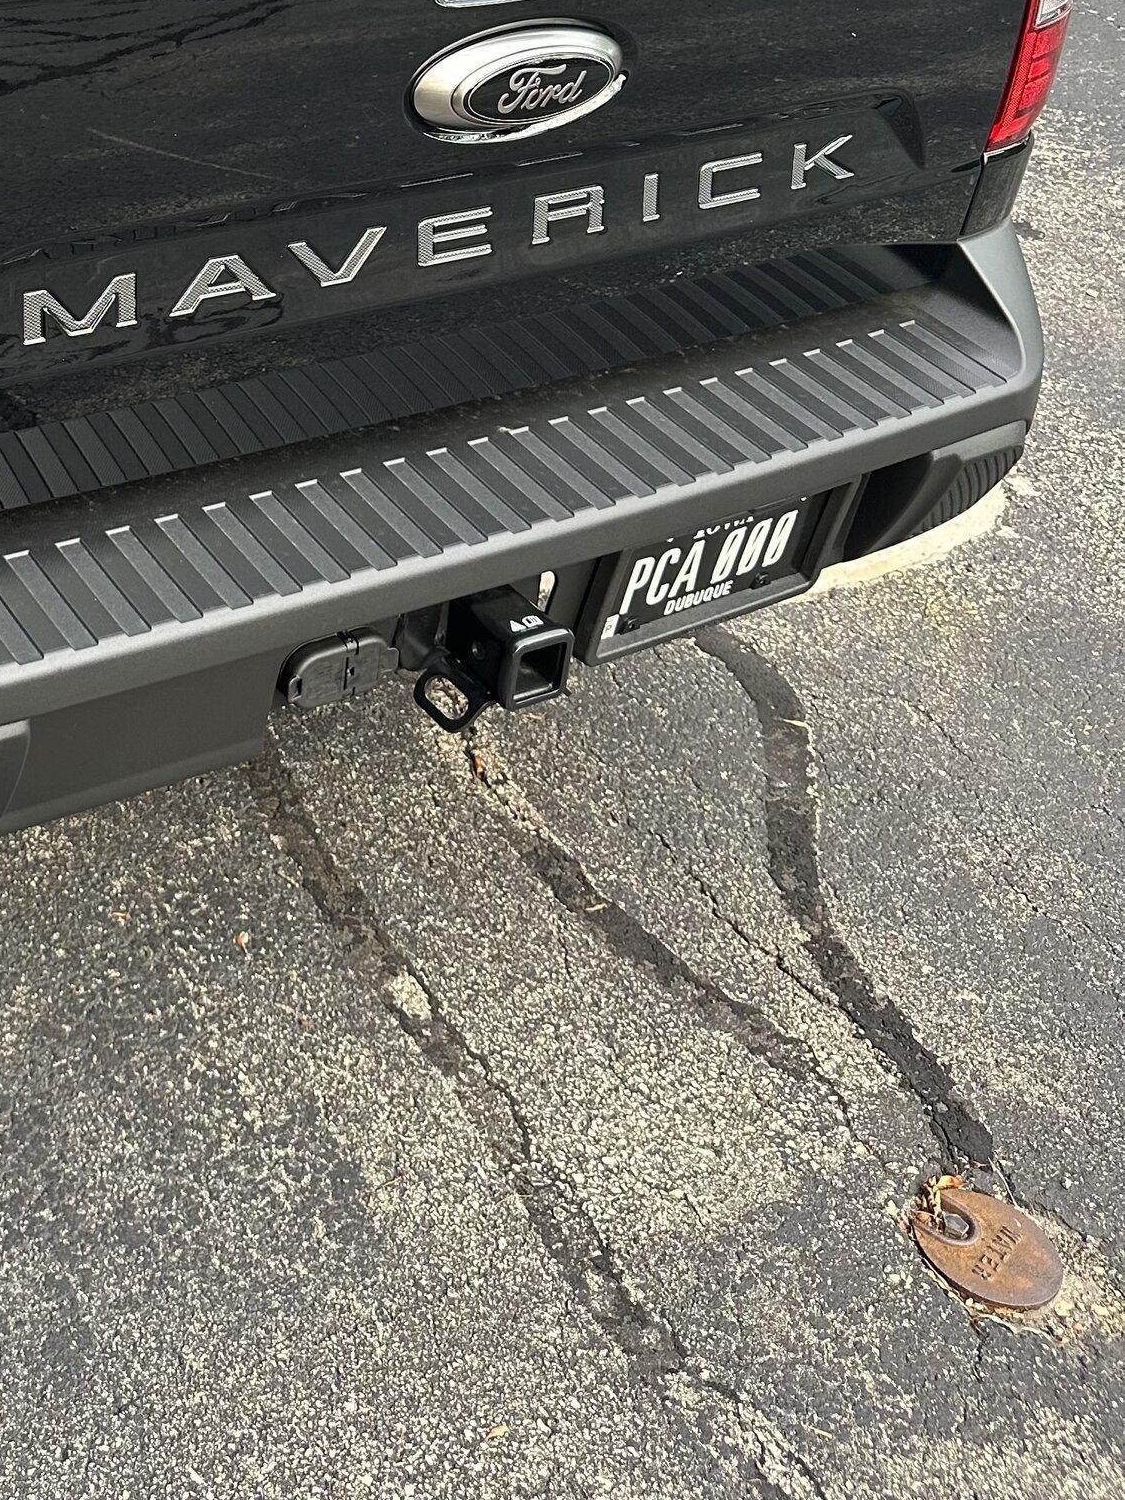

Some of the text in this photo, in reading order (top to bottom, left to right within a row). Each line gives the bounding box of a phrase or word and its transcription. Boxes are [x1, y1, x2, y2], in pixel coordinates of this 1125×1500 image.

[497, 64, 588, 114] Ford
[22, 133, 856, 345] MAVERICK
[619, 539, 706, 615] PCA
[663, 580, 734, 616] DUBUQUE
[971, 1225, 1025, 1281] WATER
